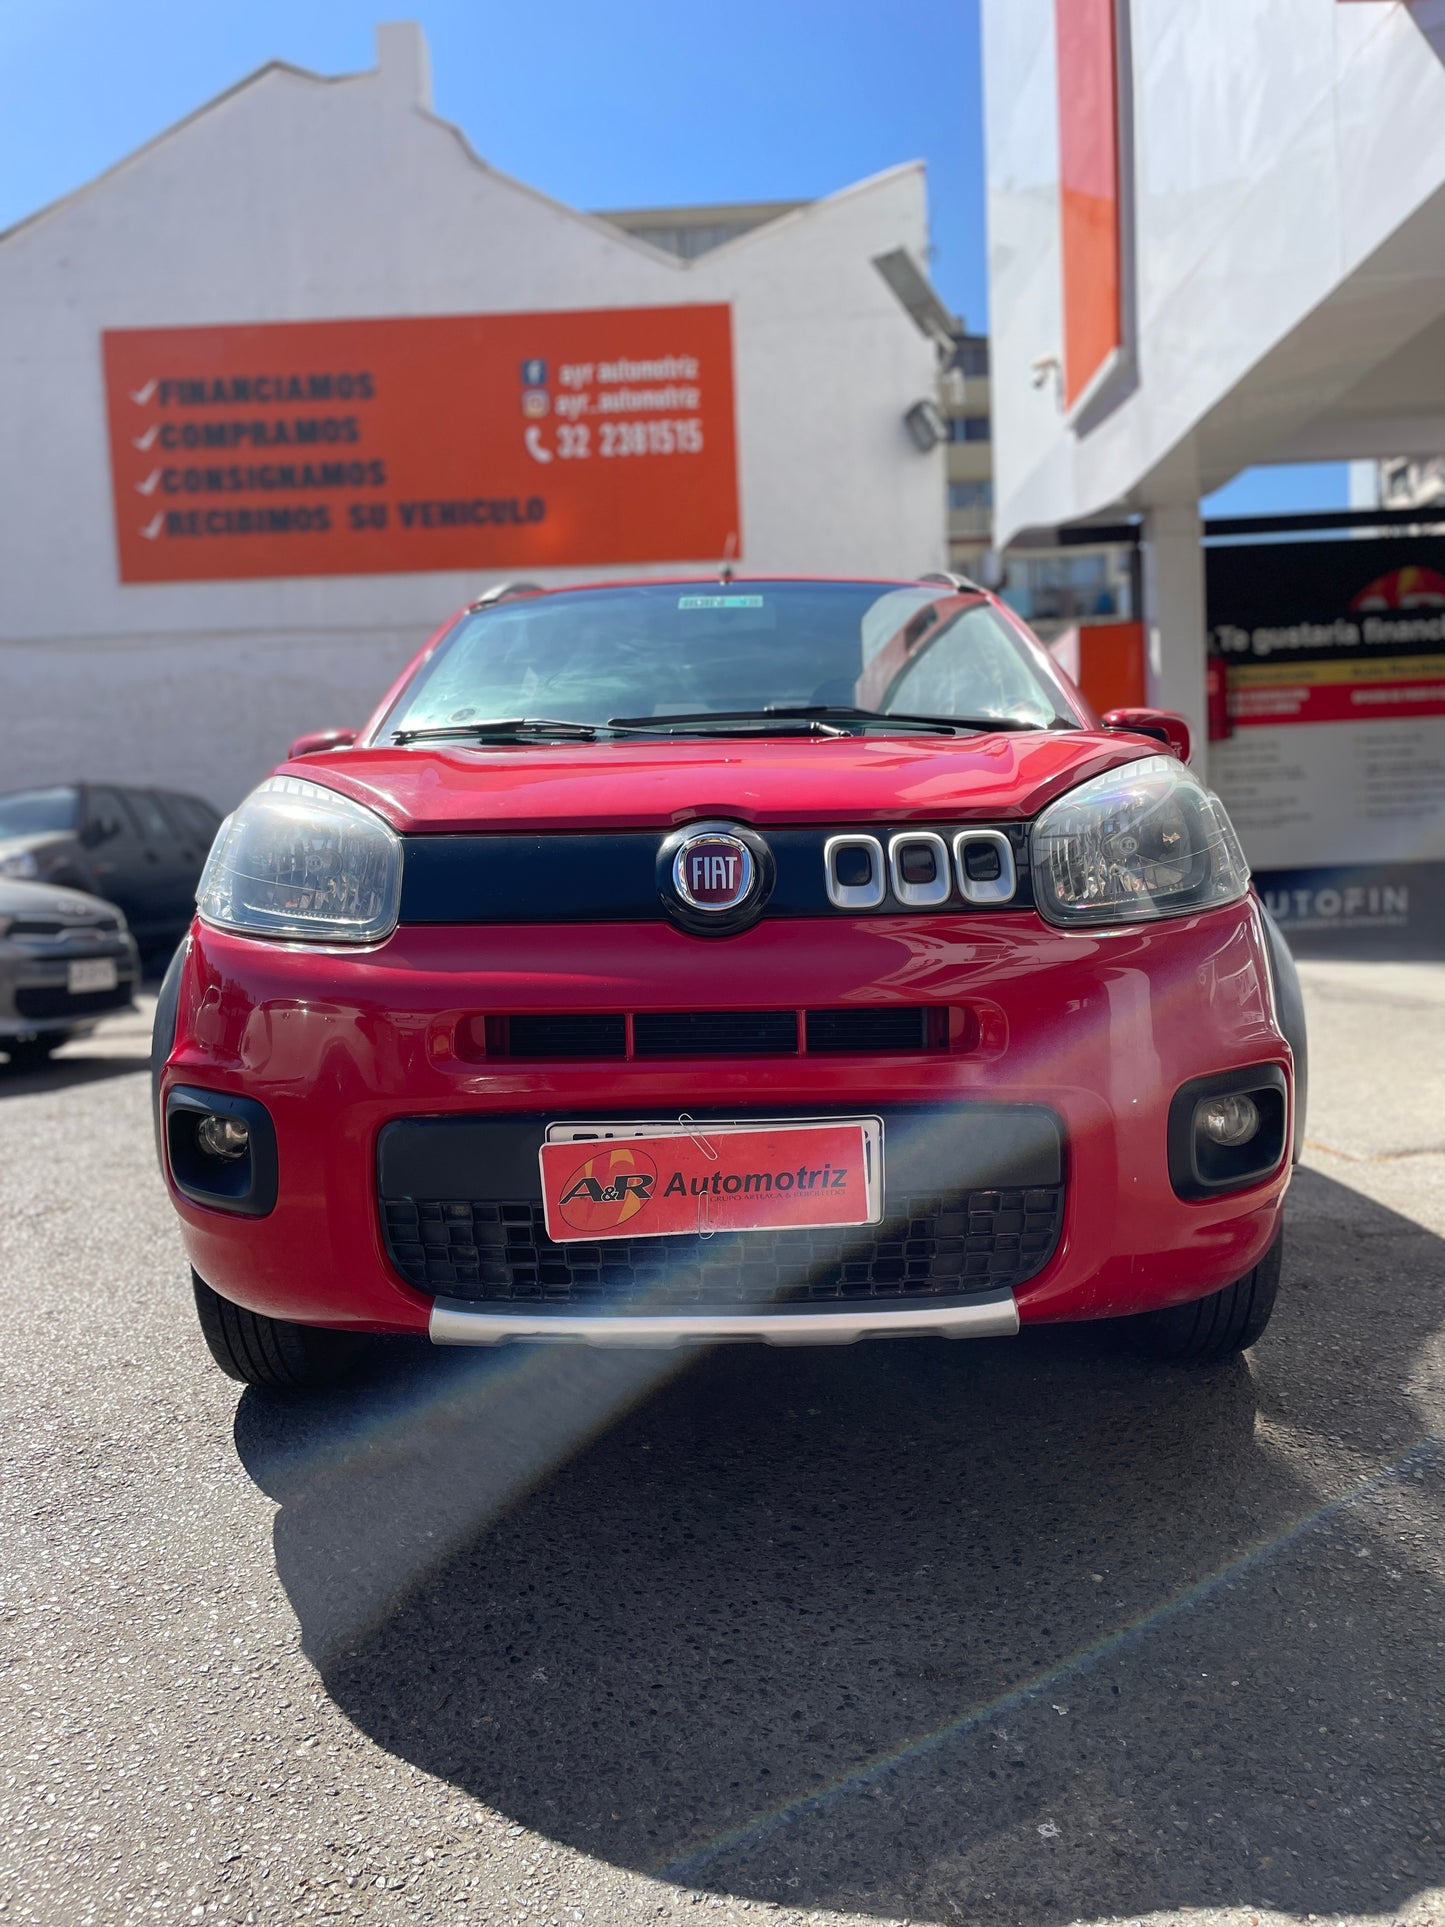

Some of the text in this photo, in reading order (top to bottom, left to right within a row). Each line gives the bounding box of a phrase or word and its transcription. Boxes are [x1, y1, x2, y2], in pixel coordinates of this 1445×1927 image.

[158, 372, 376, 407] FINANCIAMOS
[559, 356, 699, 390] ayr automotriz
[159, 416, 360, 450] COMPRAMOS
[556, 420, 703, 458] 32 2381515
[160, 459, 388, 494] CONSIGNAMOS
[165, 497, 546, 536] RECIBIMOS SU VEHICULO
[1252, 619, 1359, 656] gustaría
[692, 856, 738, 890] FIAT
[1264, 886, 1409, 918] UTOFIN
[558, 1163, 848, 1205] A&R Automotriz
